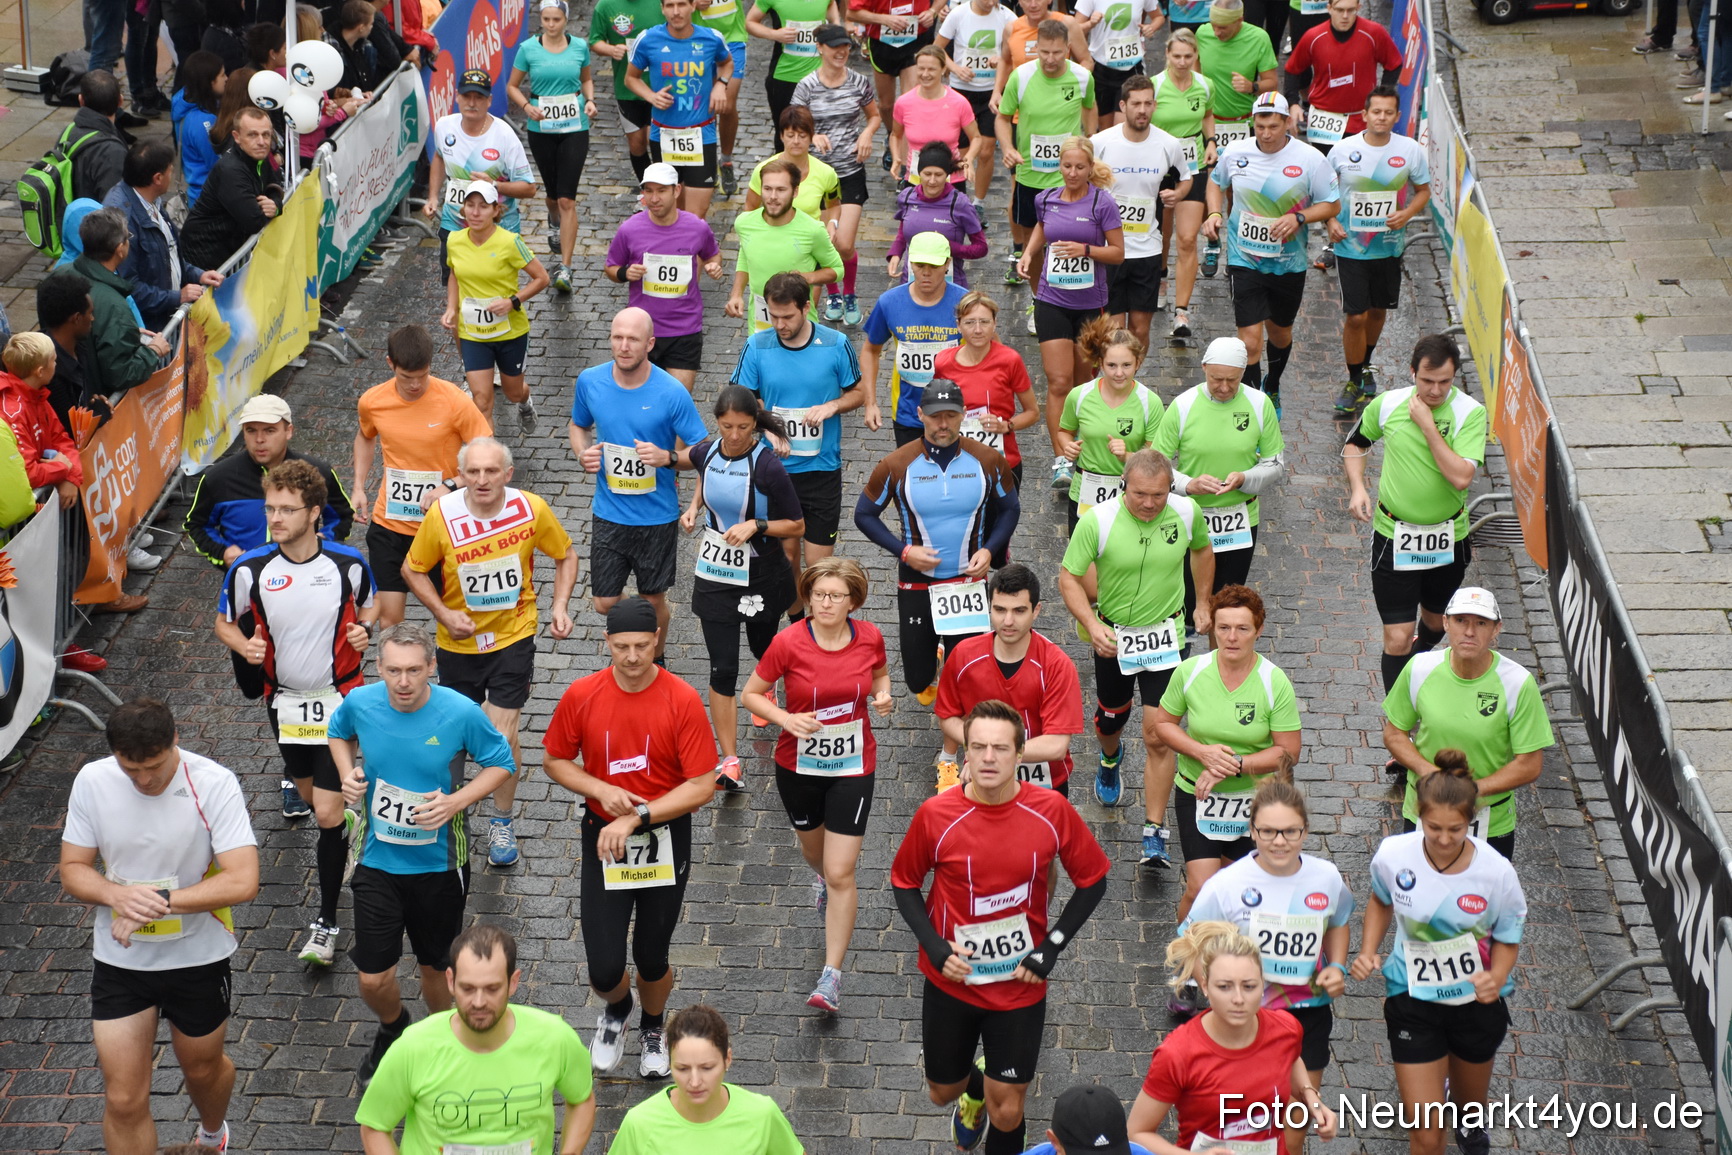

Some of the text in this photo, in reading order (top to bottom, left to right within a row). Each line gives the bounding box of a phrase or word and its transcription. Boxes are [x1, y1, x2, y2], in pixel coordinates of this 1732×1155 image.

[1109, 43, 1138, 61] 2135
[661, 62, 705, 78] RUN
[966, 57, 992, 69] 213
[544, 103, 577, 120] 2046
[1310, 114, 1343, 133] 2583
[669, 138, 694, 153] 165
[1354, 201, 1392, 217] 2677
[1052, 256, 1091, 273] 2426
[658, 265, 678, 283] 69
[1058, 276, 1083, 285] Kristina
[653, 285, 680, 294] Gerhard
[474, 308, 494, 324] 70
[476, 325, 498, 335] Marion
[896, 326, 907, 335] 10.
[905, 333, 948, 343] STADTLAUF
[613, 456, 646, 477] 248
[619, 479, 640, 489] Silvio
[456, 526, 537, 566] MAX BÖGL
[1213, 537, 1234, 547] Steve
[1400, 532, 1450, 552] 2106
[702, 540, 745, 567] 2748
[1410, 555, 1437, 565] Phillip
[706, 564, 735, 580] Barbara
[266, 575, 286, 587] tkn
[467, 567, 519, 595] 2716
[481, 593, 511, 607] Johann
[937, 592, 984, 616] 3043
[1122, 628, 1173, 655] 2504
[1136, 654, 1163, 667] Hubert
[298, 700, 325, 723] 19
[826, 707, 844, 717] DEHN
[298, 727, 325, 738] Stefan
[804, 733, 857, 757] 2581
[620, 761, 638, 771] DEHN
[817, 759, 845, 770] Carina
[1202, 795, 1252, 820] 2773
[387, 825, 418, 839] Stefan
[1209, 823, 1245, 835] Christine
[621, 868, 657, 881] Michael
[989, 894, 1018, 910] DEHN
[965, 930, 1028, 963] 2463
[1257, 928, 1317, 958] 2682
[1273, 962, 1298, 976] Lena
[1413, 951, 1476, 984] 2116
[1436, 985, 1464, 999] Rosa
